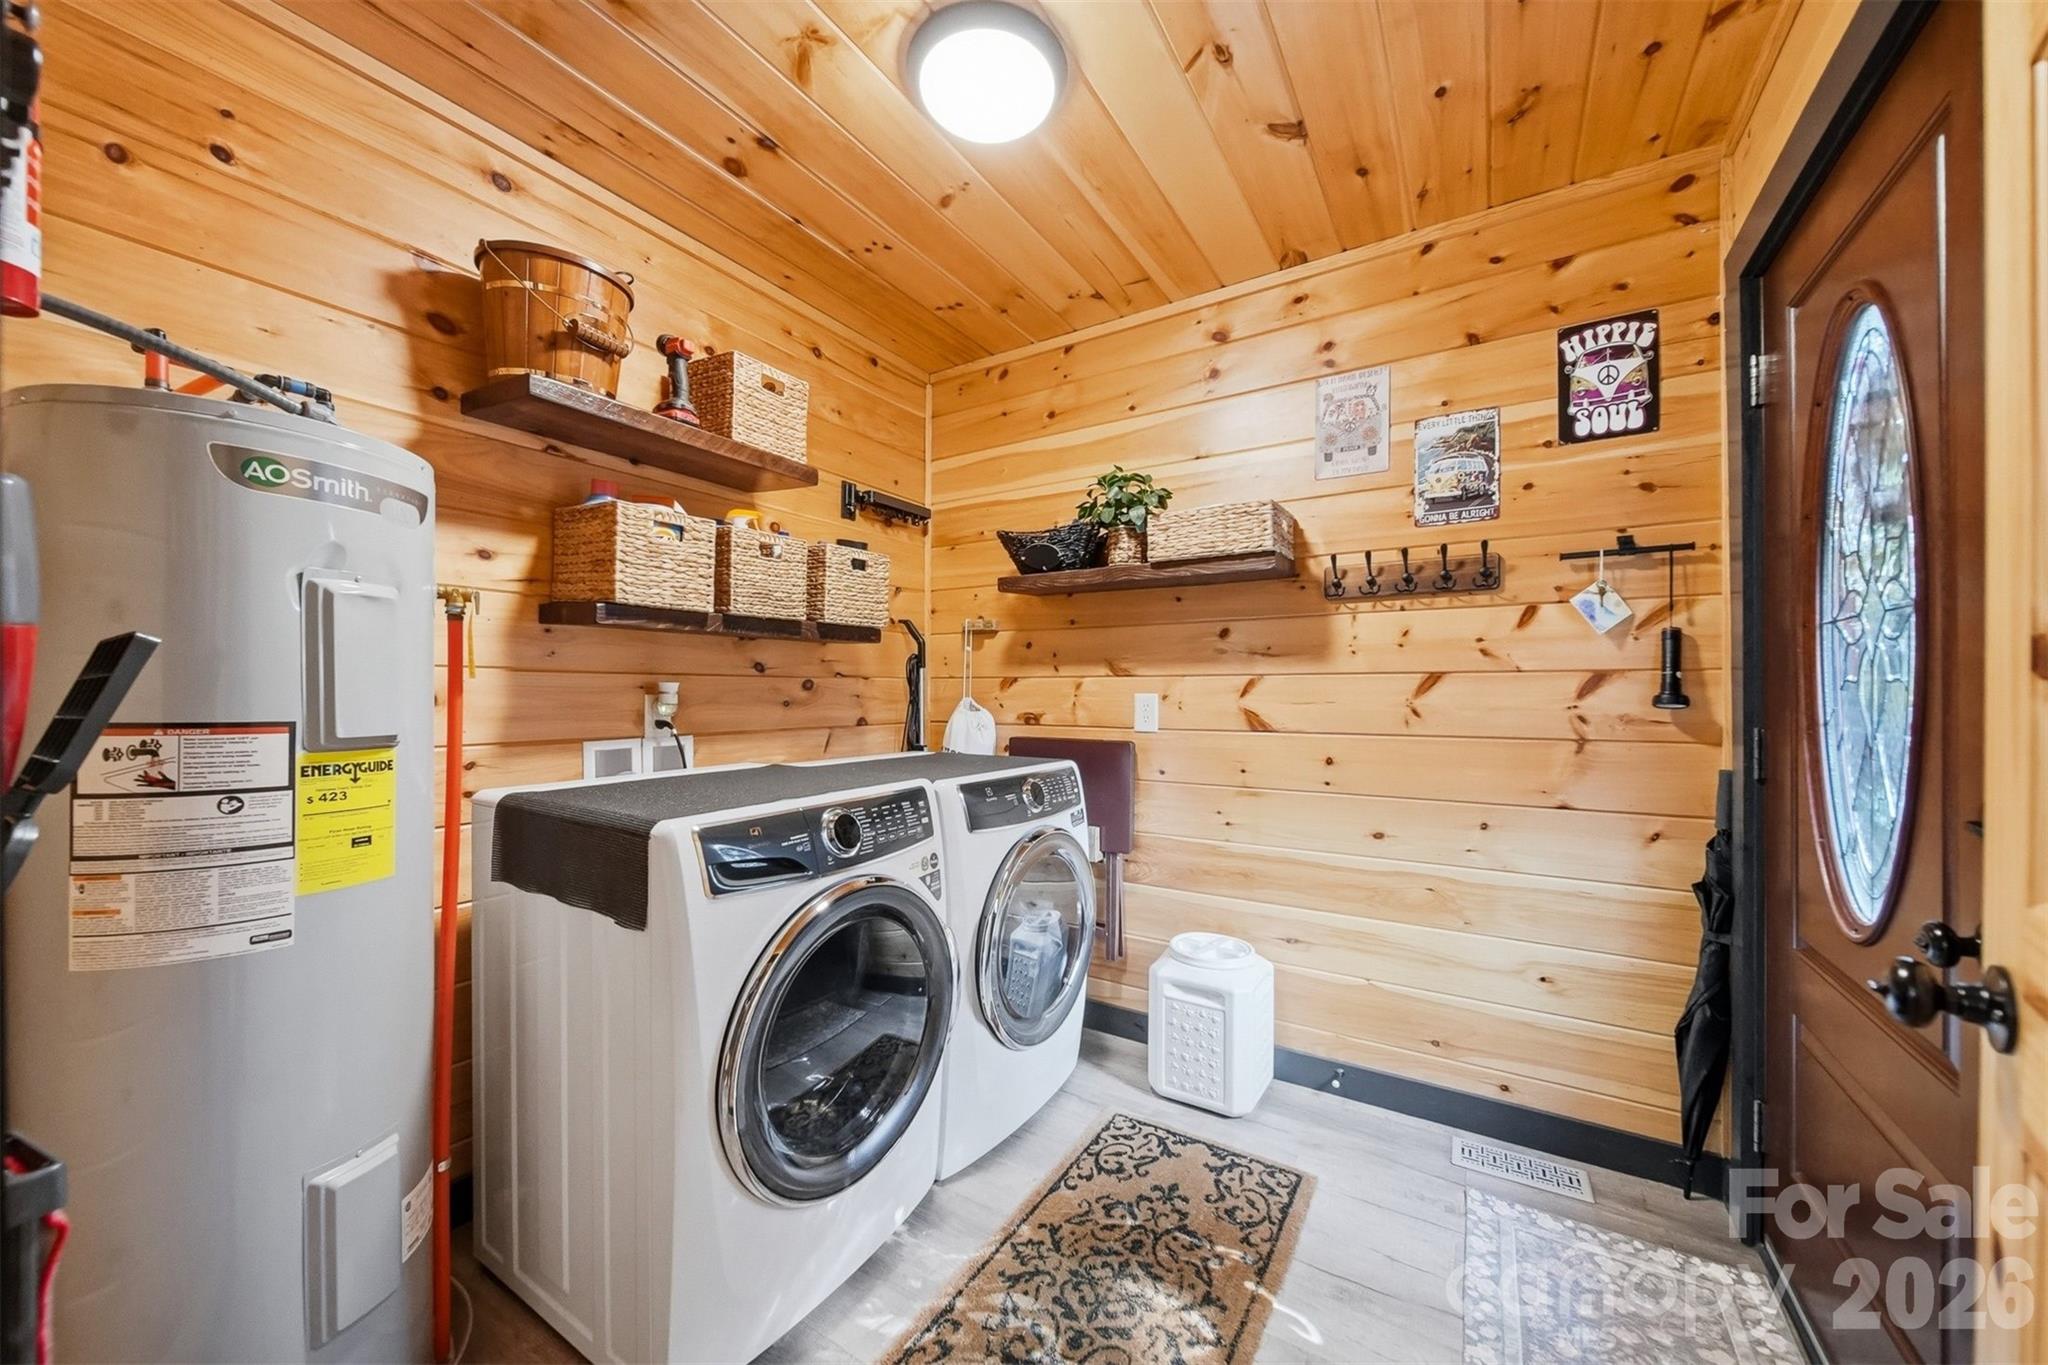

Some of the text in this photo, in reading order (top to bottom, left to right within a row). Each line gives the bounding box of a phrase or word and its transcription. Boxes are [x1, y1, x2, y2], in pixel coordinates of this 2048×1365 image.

[1560, 322, 1657, 362] HIPPIE
[1442, 416, 1466, 427] LITTLE
[1574, 401, 1644, 437] SOUL
[1420, 513, 1448, 523] GONNA
[1449, 511, 1458, 520] BE
[318, 791, 348, 802] 423
